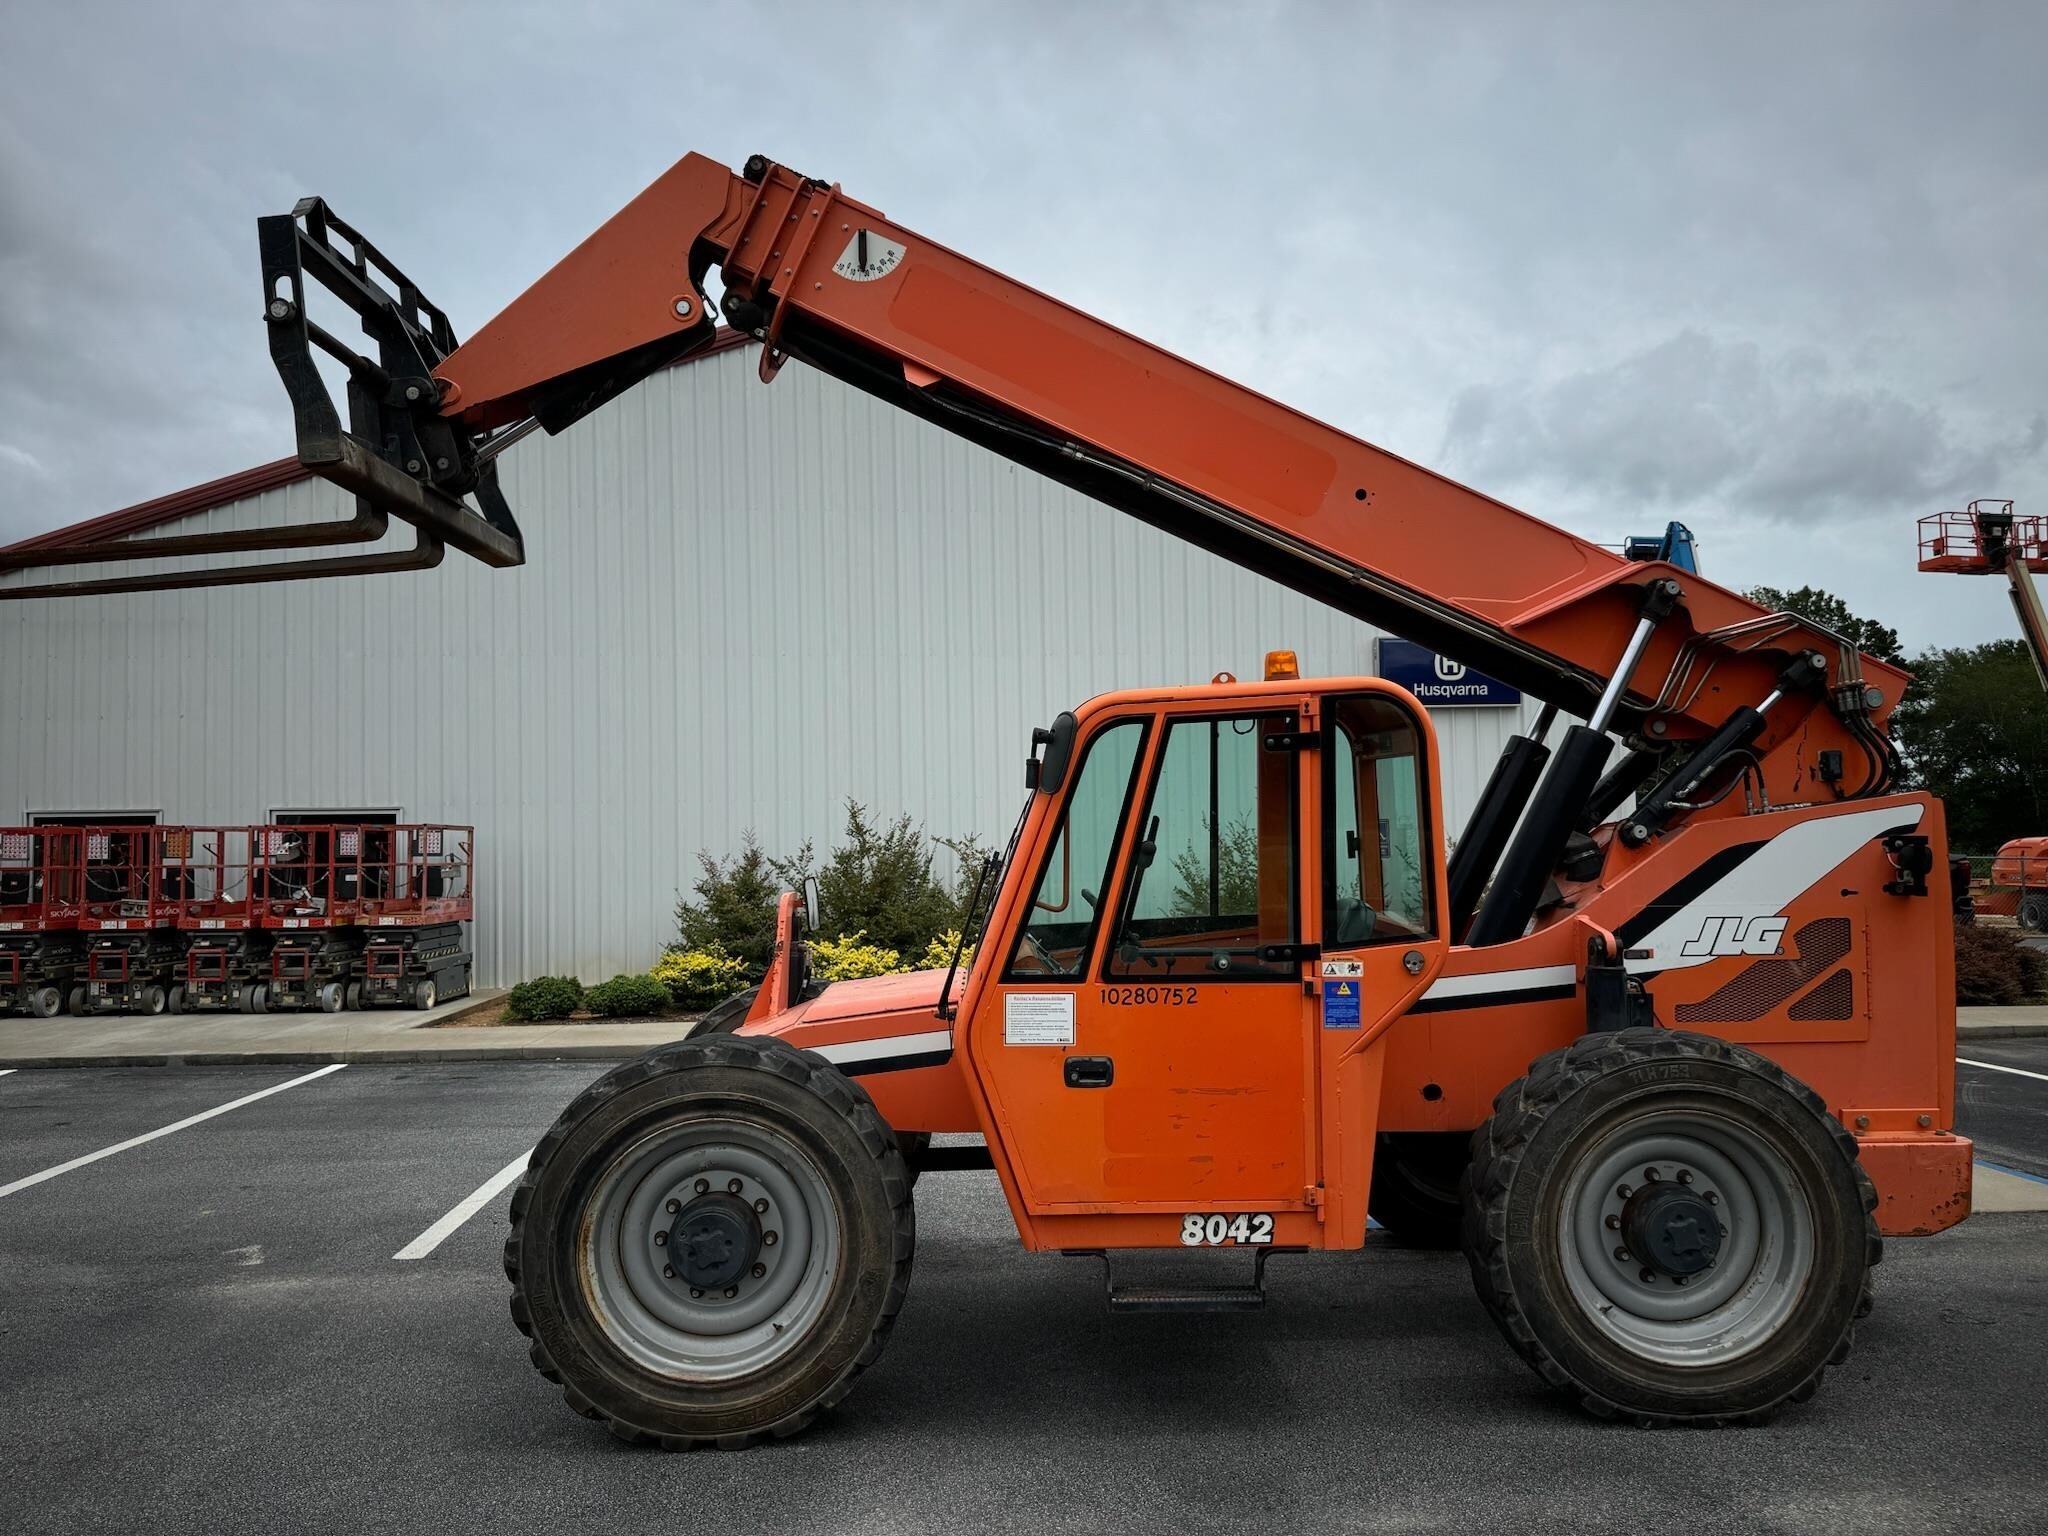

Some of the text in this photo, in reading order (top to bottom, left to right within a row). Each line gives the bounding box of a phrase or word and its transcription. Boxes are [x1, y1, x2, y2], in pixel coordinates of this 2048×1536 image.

[1413, 683, 1488, 698] Husqvarna
[1680, 916, 1791, 957] JLG
[1100, 987, 1198, 1006] 10280752
[1181, 1214, 1273, 1246] 8042
